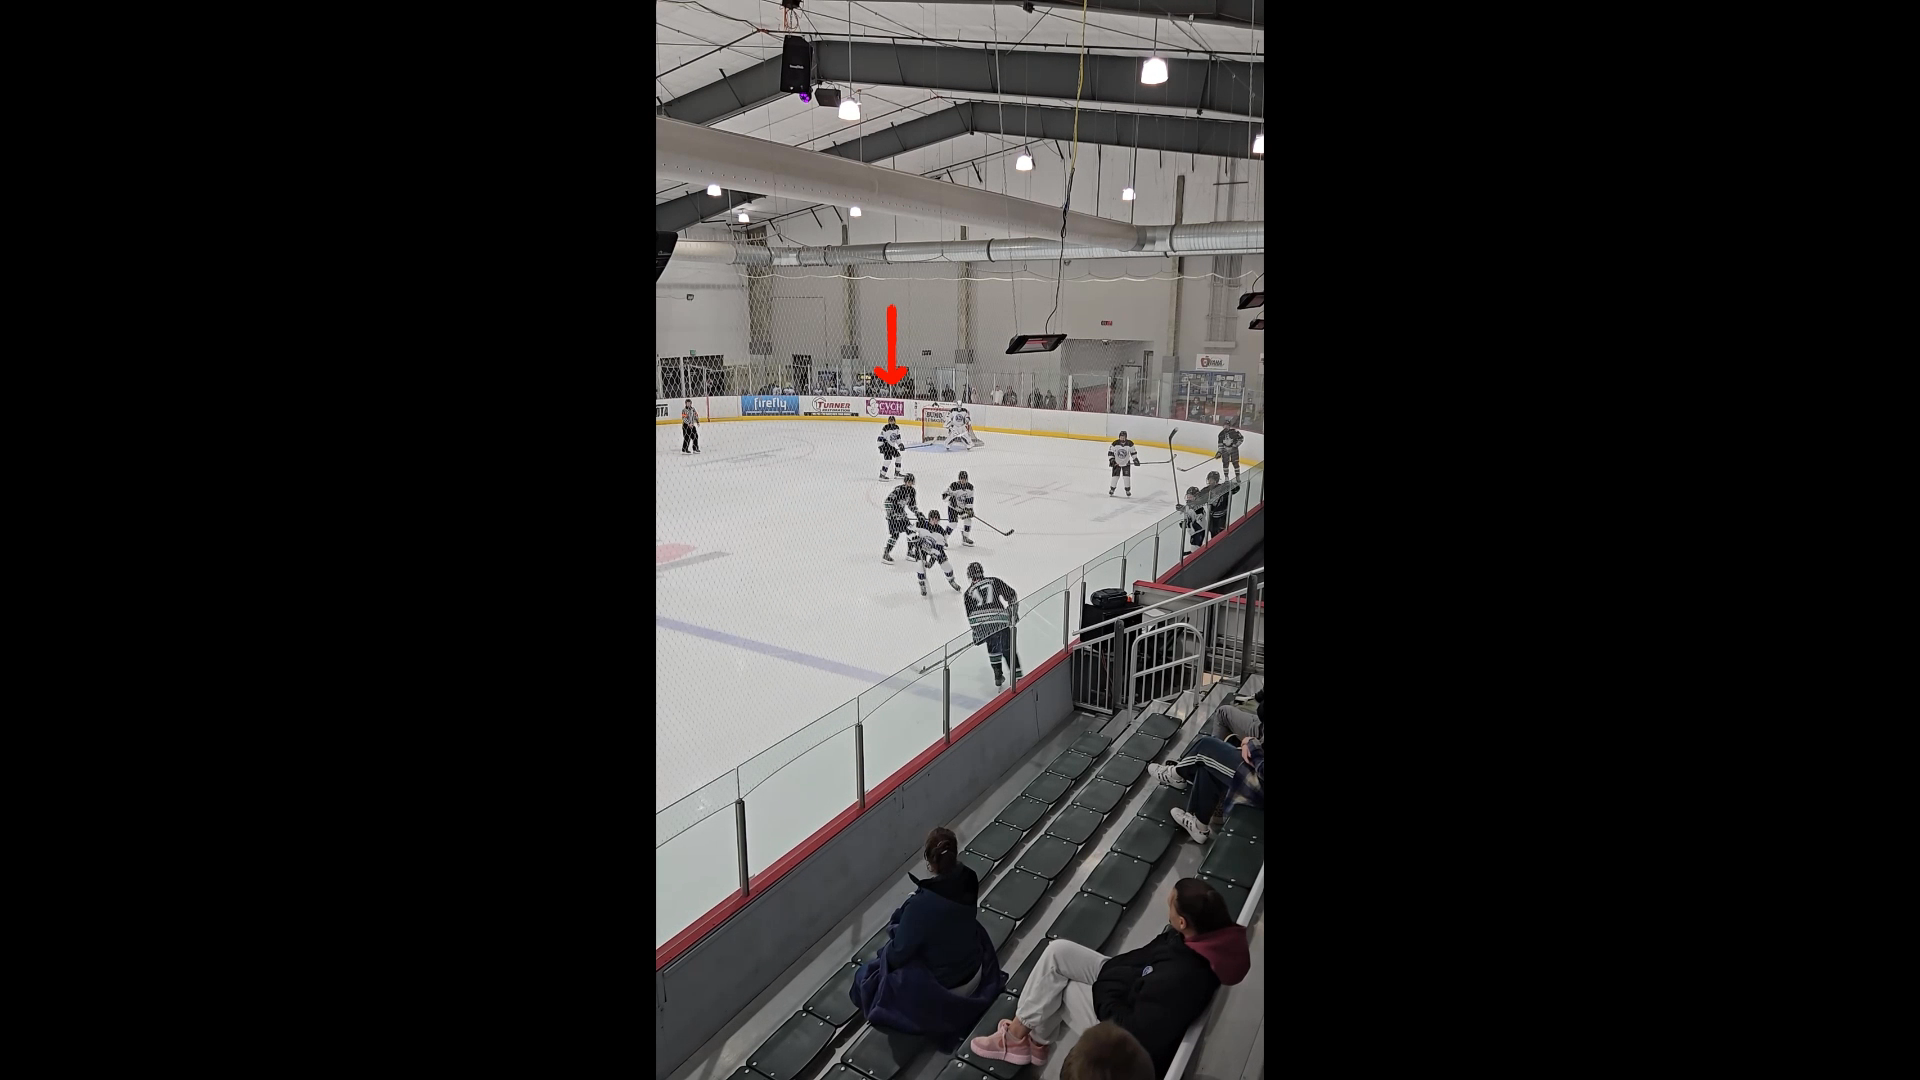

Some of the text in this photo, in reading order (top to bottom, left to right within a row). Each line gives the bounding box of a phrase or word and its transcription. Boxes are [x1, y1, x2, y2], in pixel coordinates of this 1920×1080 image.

[754, 398, 787, 410] firefly
[818, 401, 851, 409] TURNER
[879, 402, 903, 411] CVCH
